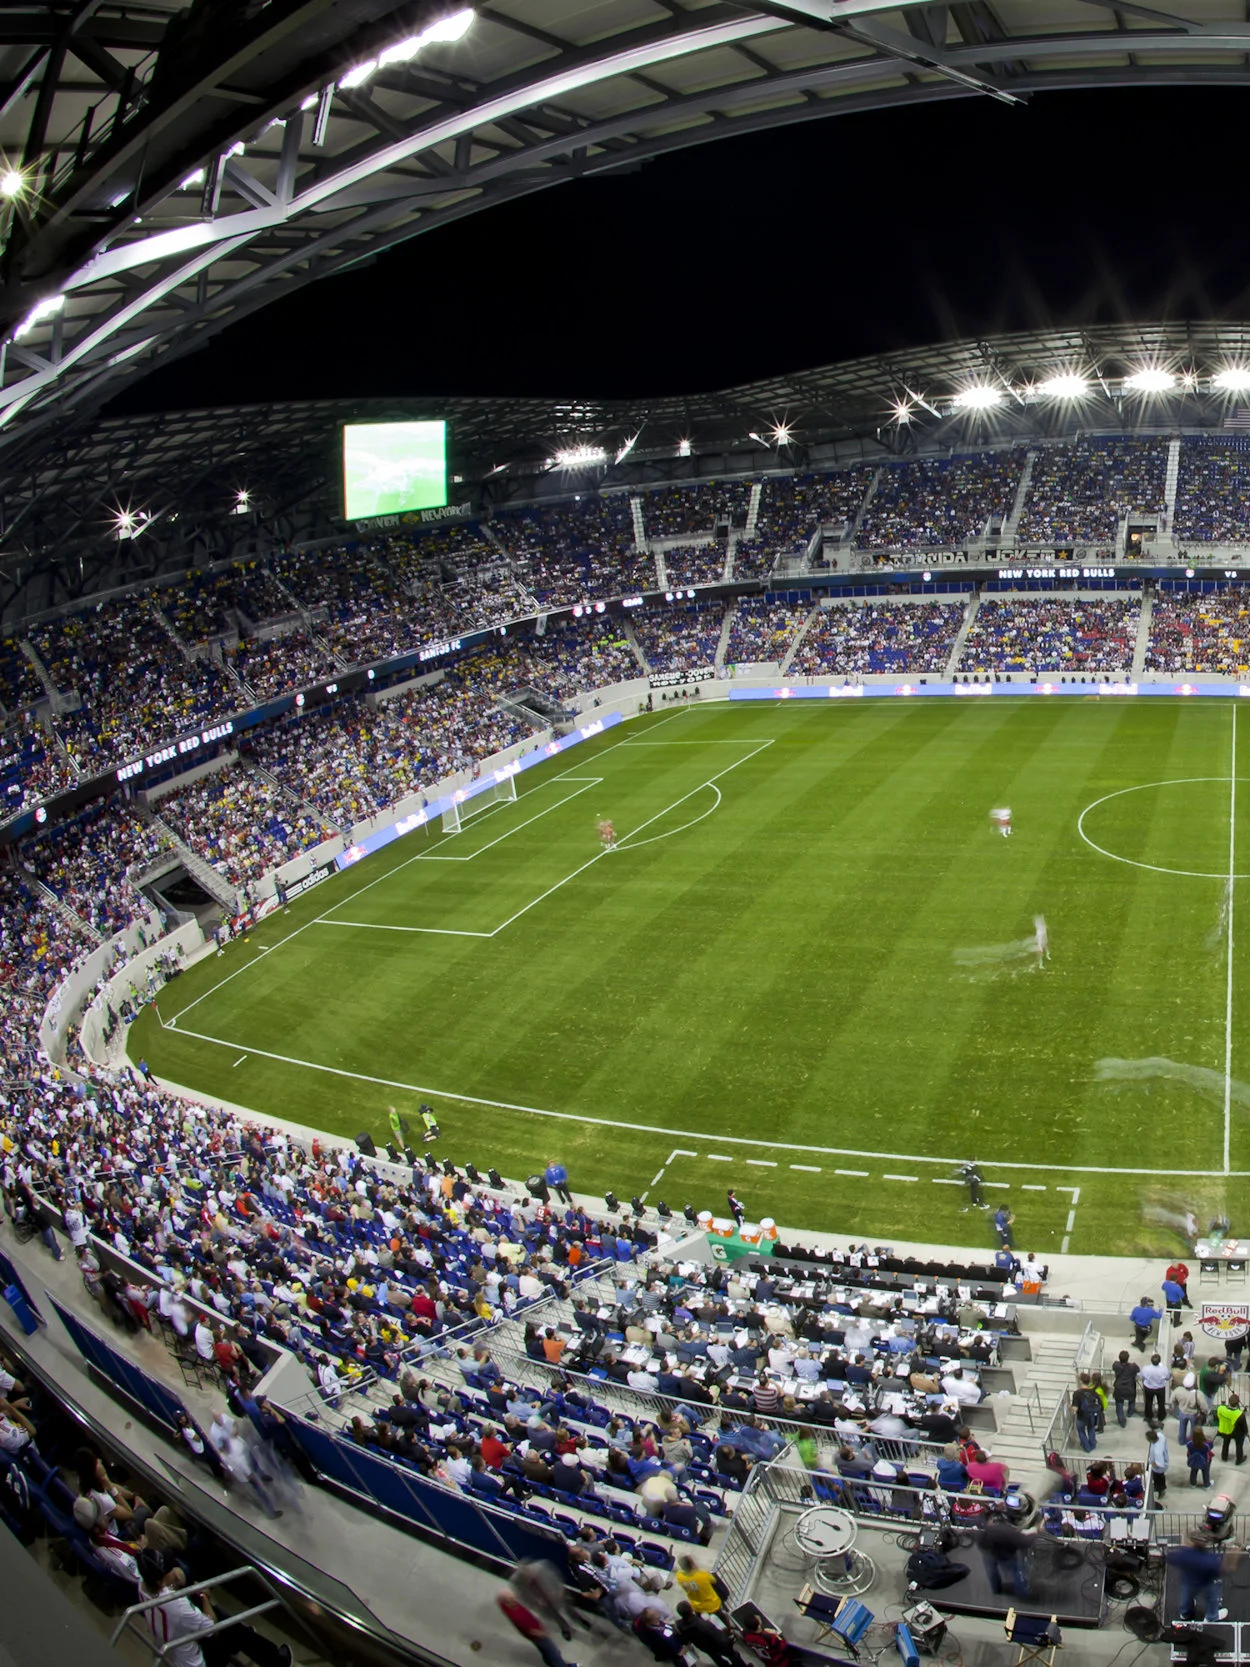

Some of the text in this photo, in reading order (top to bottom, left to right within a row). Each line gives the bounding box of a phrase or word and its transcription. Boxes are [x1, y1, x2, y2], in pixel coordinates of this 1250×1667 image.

[999, 568, 1116, 579] NEW YORK RED BULLS
[116, 722, 234, 782] NEW YORK RED BULLS
[302, 868, 330, 889] adidas
